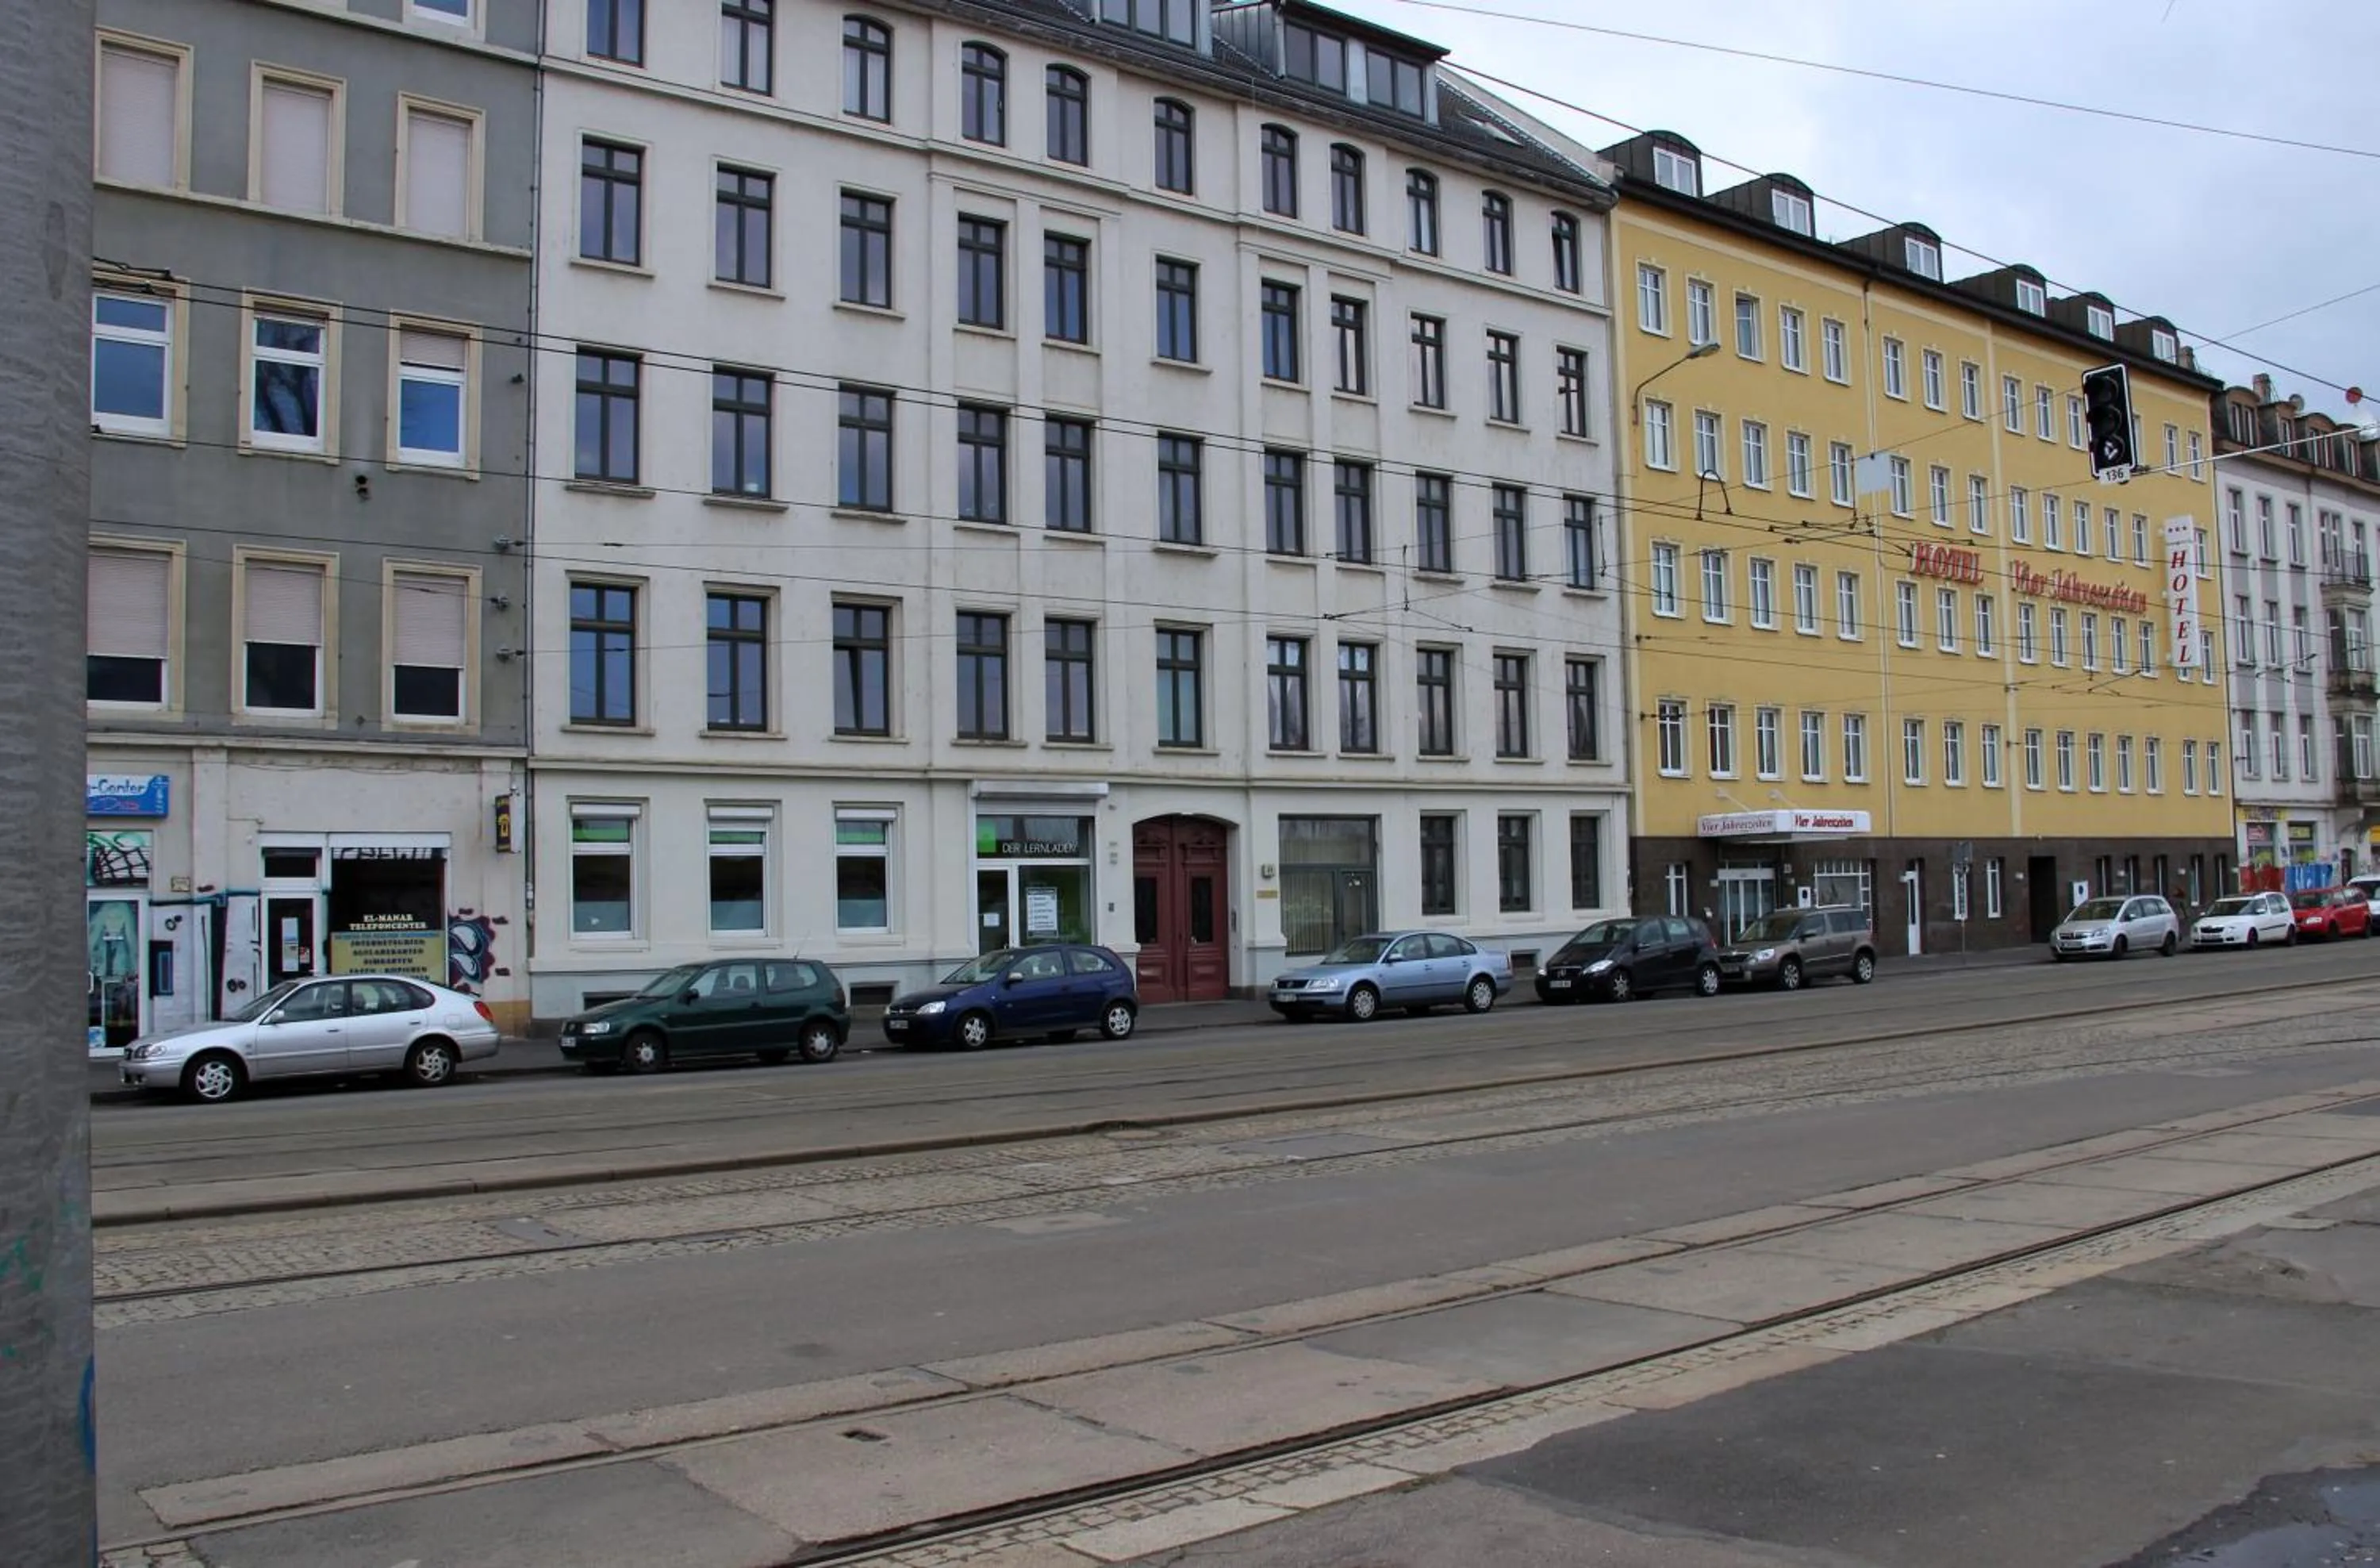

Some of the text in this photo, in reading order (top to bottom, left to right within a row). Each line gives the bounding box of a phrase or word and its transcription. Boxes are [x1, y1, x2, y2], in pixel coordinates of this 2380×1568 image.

[2106, 467, 2124, 482] 136
[1911, 541, 1983, 586] HOTEL
[2170, 550, 2191, 663] HOTEL
[87, 778, 144, 794] -Center
[1702, 821, 1718, 832] Vier
[1795, 815, 1810, 828] Vier
[1002, 842, 1077, 854] DER LERNLADEN
[363, 913, 414, 923] EL-MANAR
[349, 922, 427, 931] TELEFONCENTER
